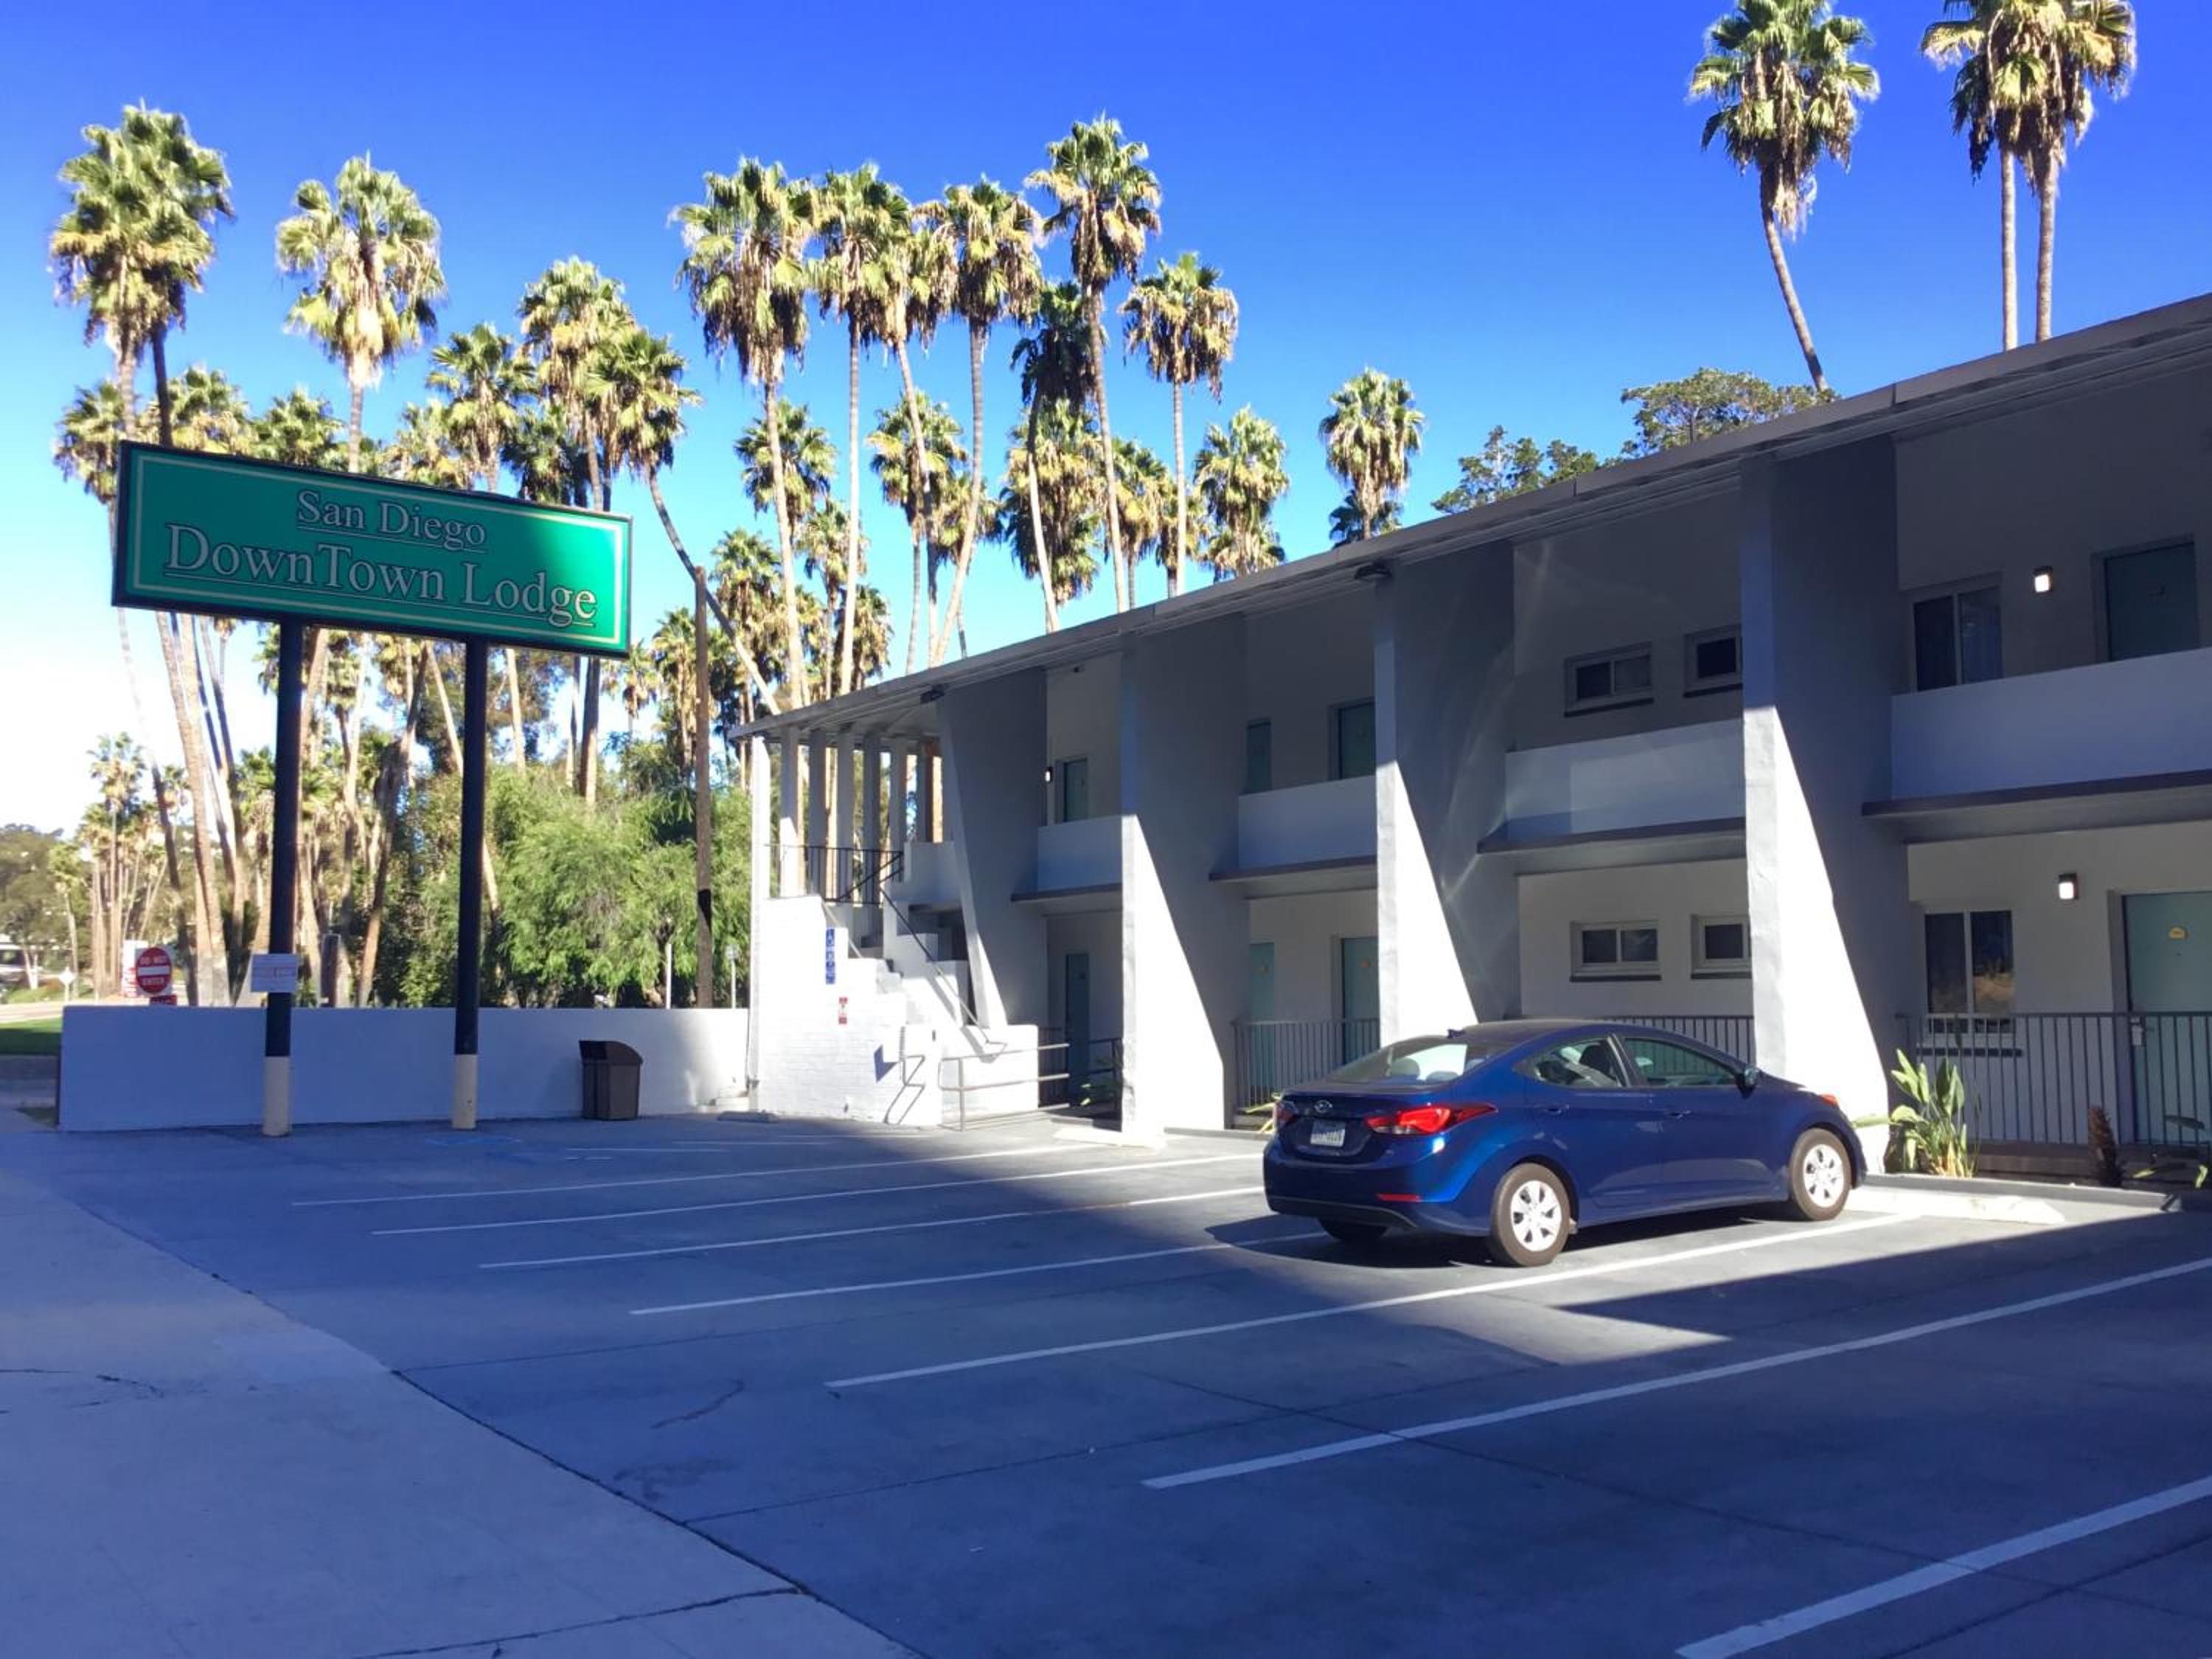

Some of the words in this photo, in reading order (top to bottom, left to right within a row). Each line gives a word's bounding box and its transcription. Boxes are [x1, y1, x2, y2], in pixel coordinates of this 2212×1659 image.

[298, 490, 366, 529] San
[378, 501, 486, 552] Diego
[164, 523, 445, 601] DownTown
[462, 562, 598, 627] Lodge
